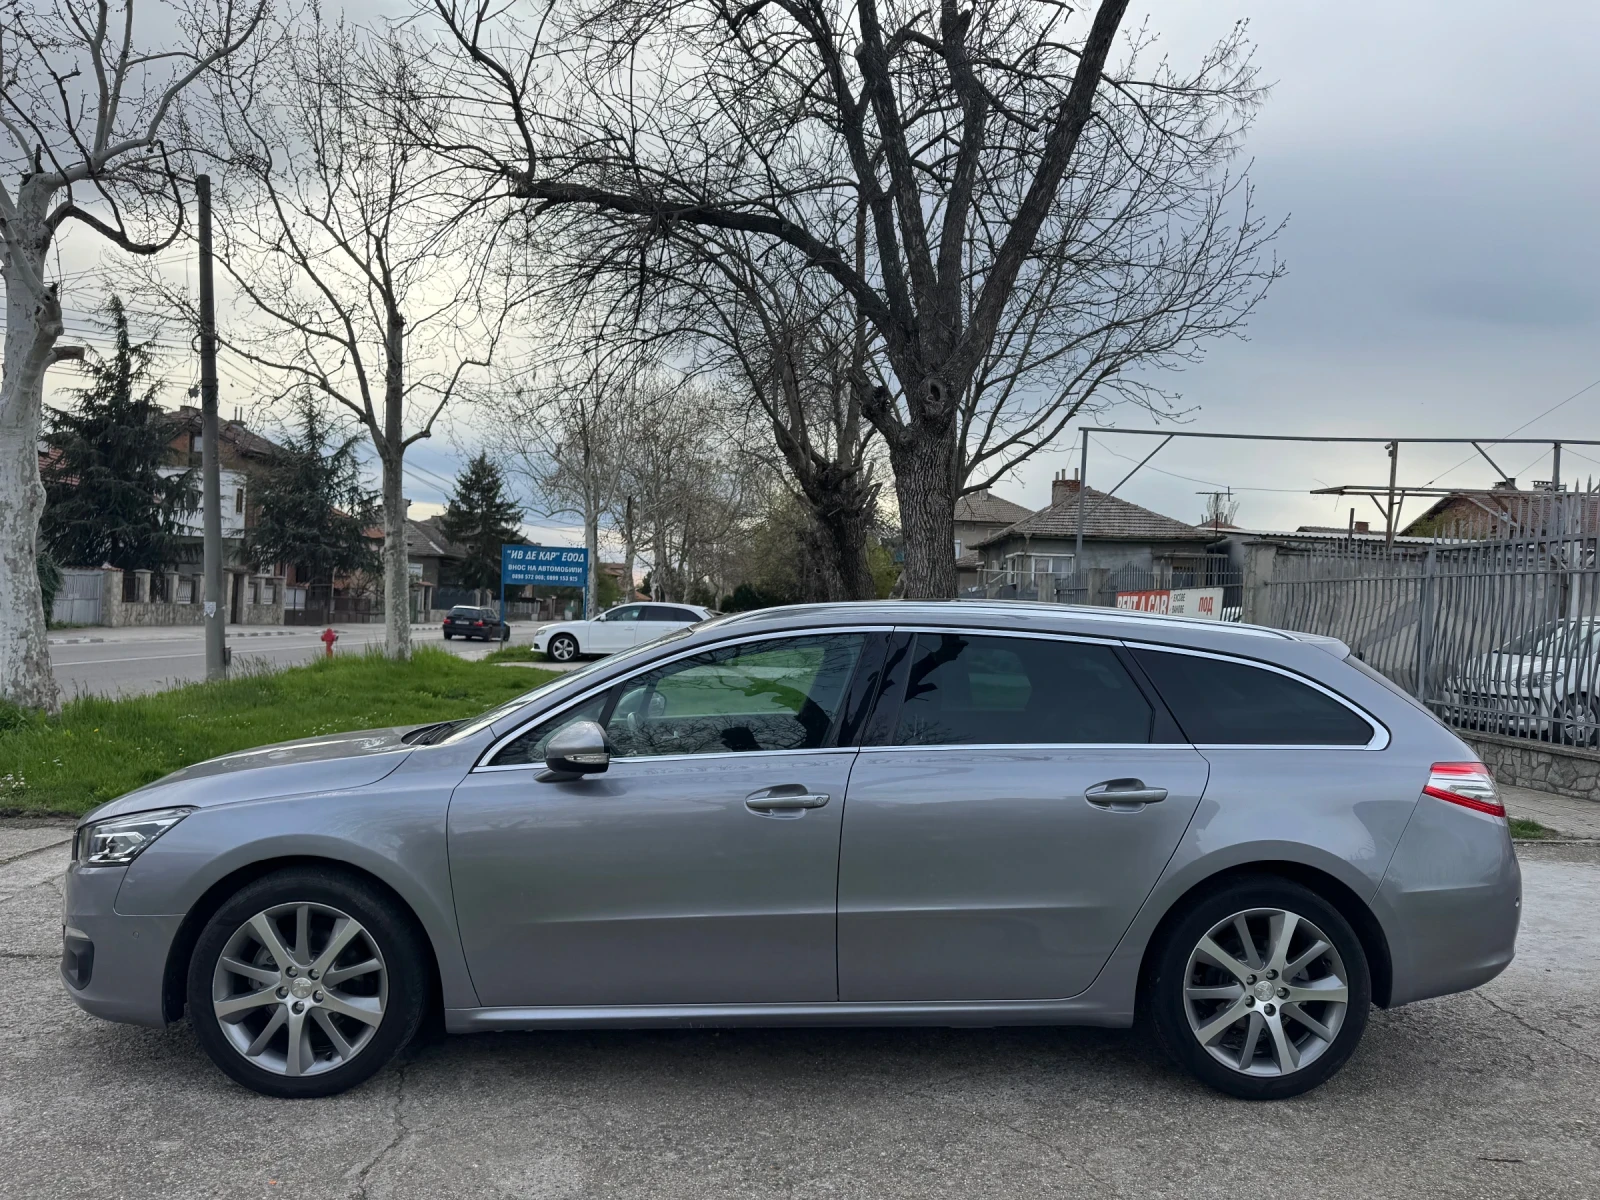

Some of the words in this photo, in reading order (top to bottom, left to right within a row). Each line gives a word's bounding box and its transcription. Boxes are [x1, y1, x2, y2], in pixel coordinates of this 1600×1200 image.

[525, 551, 537, 560] ДЕ
[538, 551, 560, 561] КАР"
[561, 552, 585, 563] ЕООД
[538, 565, 583, 574] АВТОМОБИЛИ
[1139, 595, 1146, 612] A
[1147, 594, 1168, 615] CAR
[1198, 596, 1214, 616] ПОД
